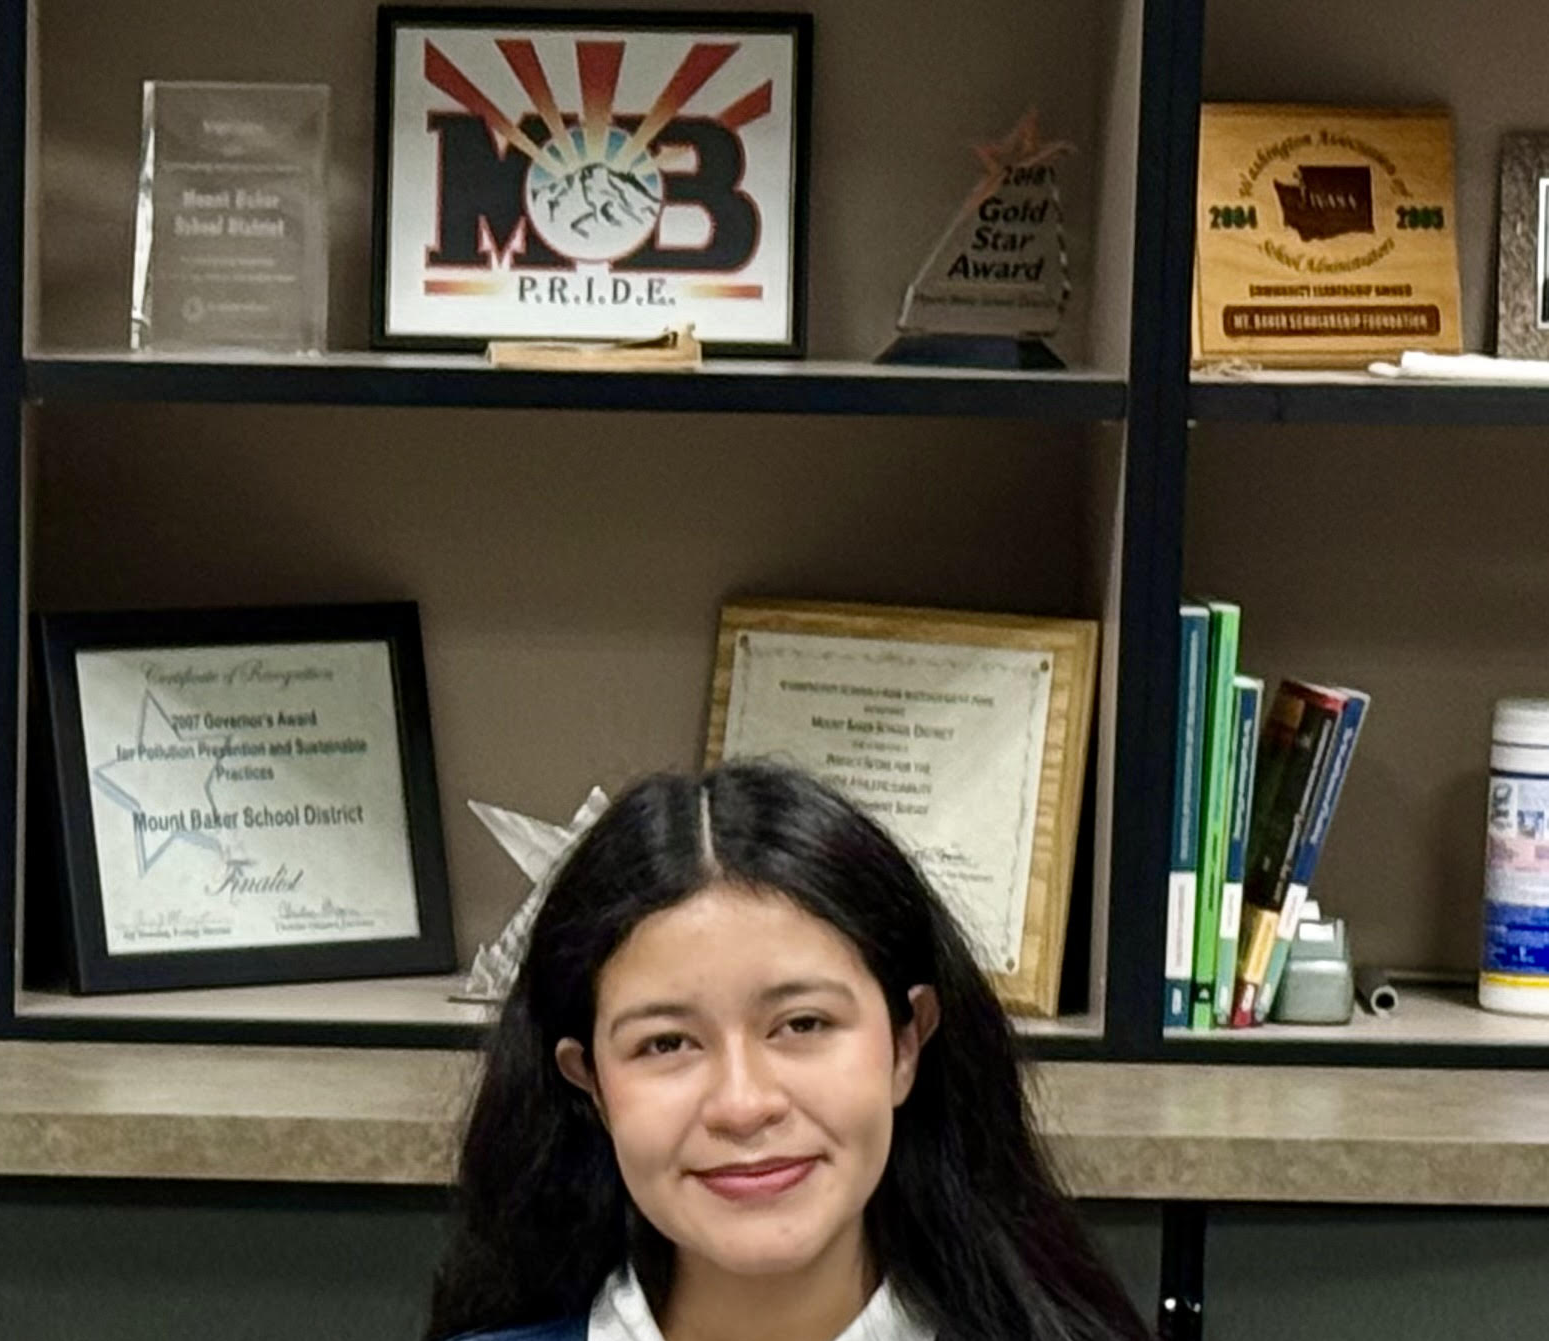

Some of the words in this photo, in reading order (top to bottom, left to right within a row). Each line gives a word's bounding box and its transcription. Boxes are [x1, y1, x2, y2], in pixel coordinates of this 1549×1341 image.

[978, 196, 1050, 223] Gold
[971, 226, 1036, 252] Star
[947, 254, 1045, 282] Award
[517, 275, 677, 306] P.R.I.D.E.
[204, 712, 275, 730] Governor's
[277, 709, 318, 728] Award
[133, 812, 187, 832] Mount
[190, 808, 238, 831] Baker
[243, 806, 300, 828] School
[304, 804, 365, 827] District
